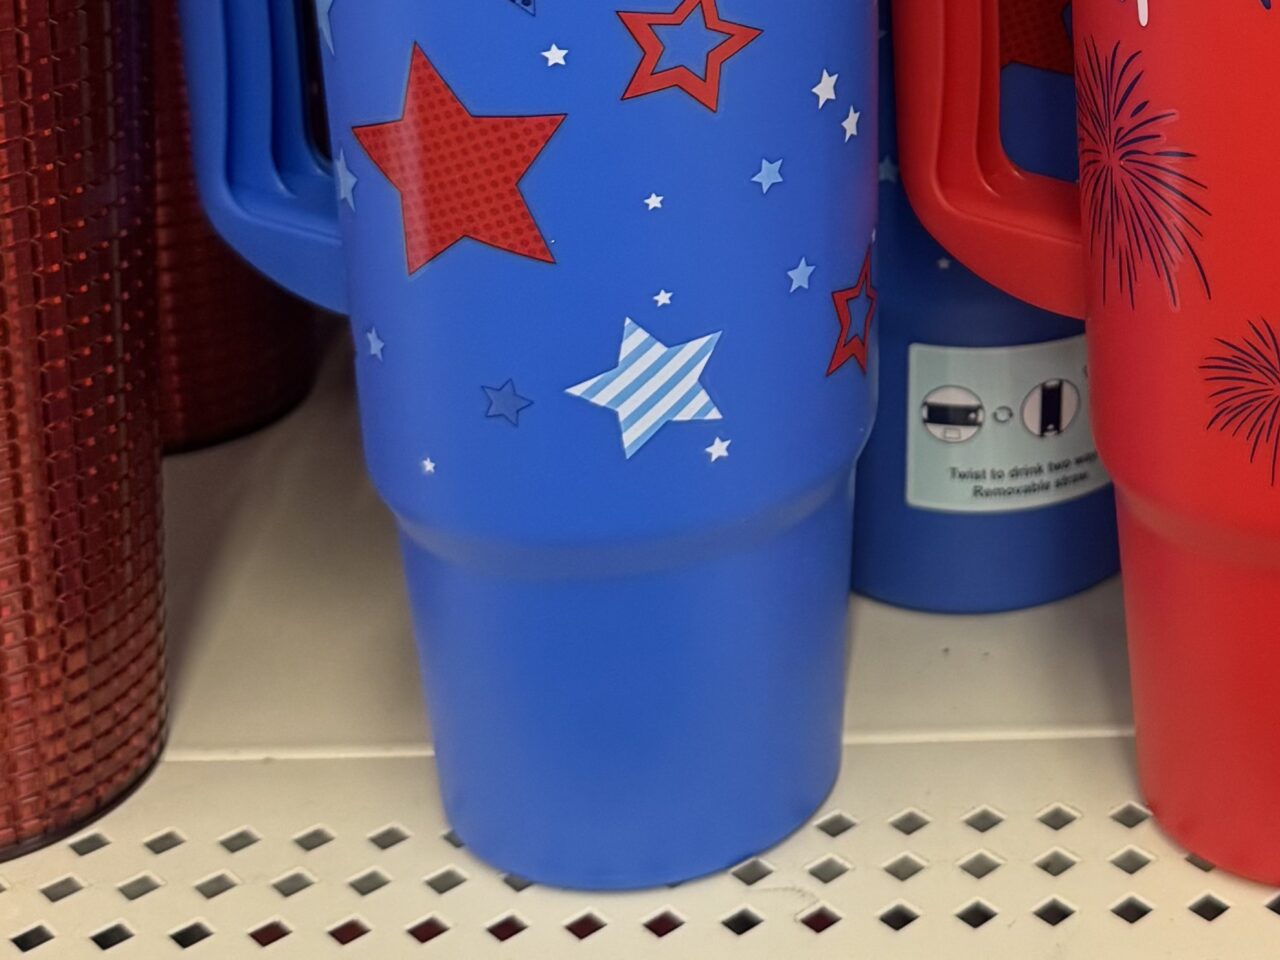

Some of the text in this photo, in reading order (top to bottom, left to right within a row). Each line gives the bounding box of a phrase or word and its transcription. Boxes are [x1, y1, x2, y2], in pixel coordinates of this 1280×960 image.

[950, 466, 987, 480] Twist
[990, 468, 1005, 480] to
[1008, 463, 1045, 478] drink
[1048, 460, 1072, 472] two
[972, 482, 1050, 497] Removable
